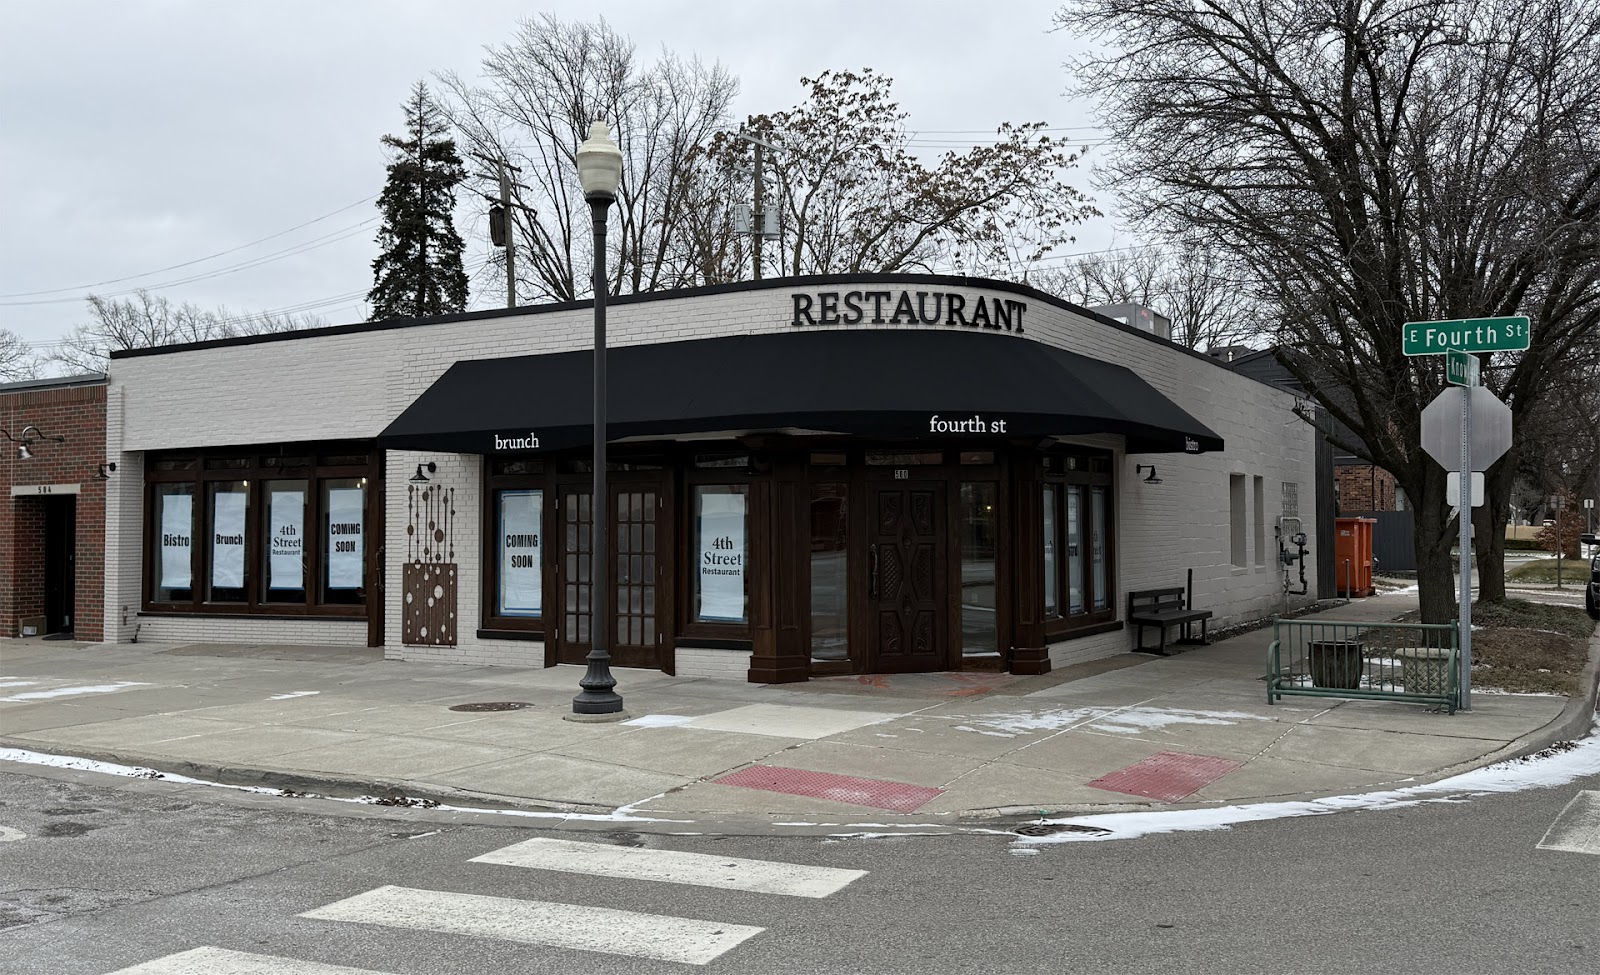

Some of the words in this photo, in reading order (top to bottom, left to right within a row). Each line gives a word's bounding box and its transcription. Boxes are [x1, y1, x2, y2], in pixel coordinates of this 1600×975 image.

[791, 290, 1027, 333] RESTAURANT
[1410, 330, 1418, 342] E
[1426, 326, 1497, 347] Fourth
[1505, 324, 1522, 337] St
[929, 415, 986, 433] fourth
[990, 419, 1007, 433] st
[495, 432, 540, 450] brunch
[280, 524, 296, 535] 4th
[330, 523, 361, 535] COMING
[163, 534, 190, 547] Bistro
[215, 533, 243, 545] Brunch
[273, 536, 302, 548] Street
[505, 534, 538, 548] COMING
[712, 536, 733, 550] 4th
[335, 540, 356, 552] SOON
[511, 555, 533, 568] SOON
[703, 551, 742, 566] Street
[702, 567, 740, 576] Restaurant
